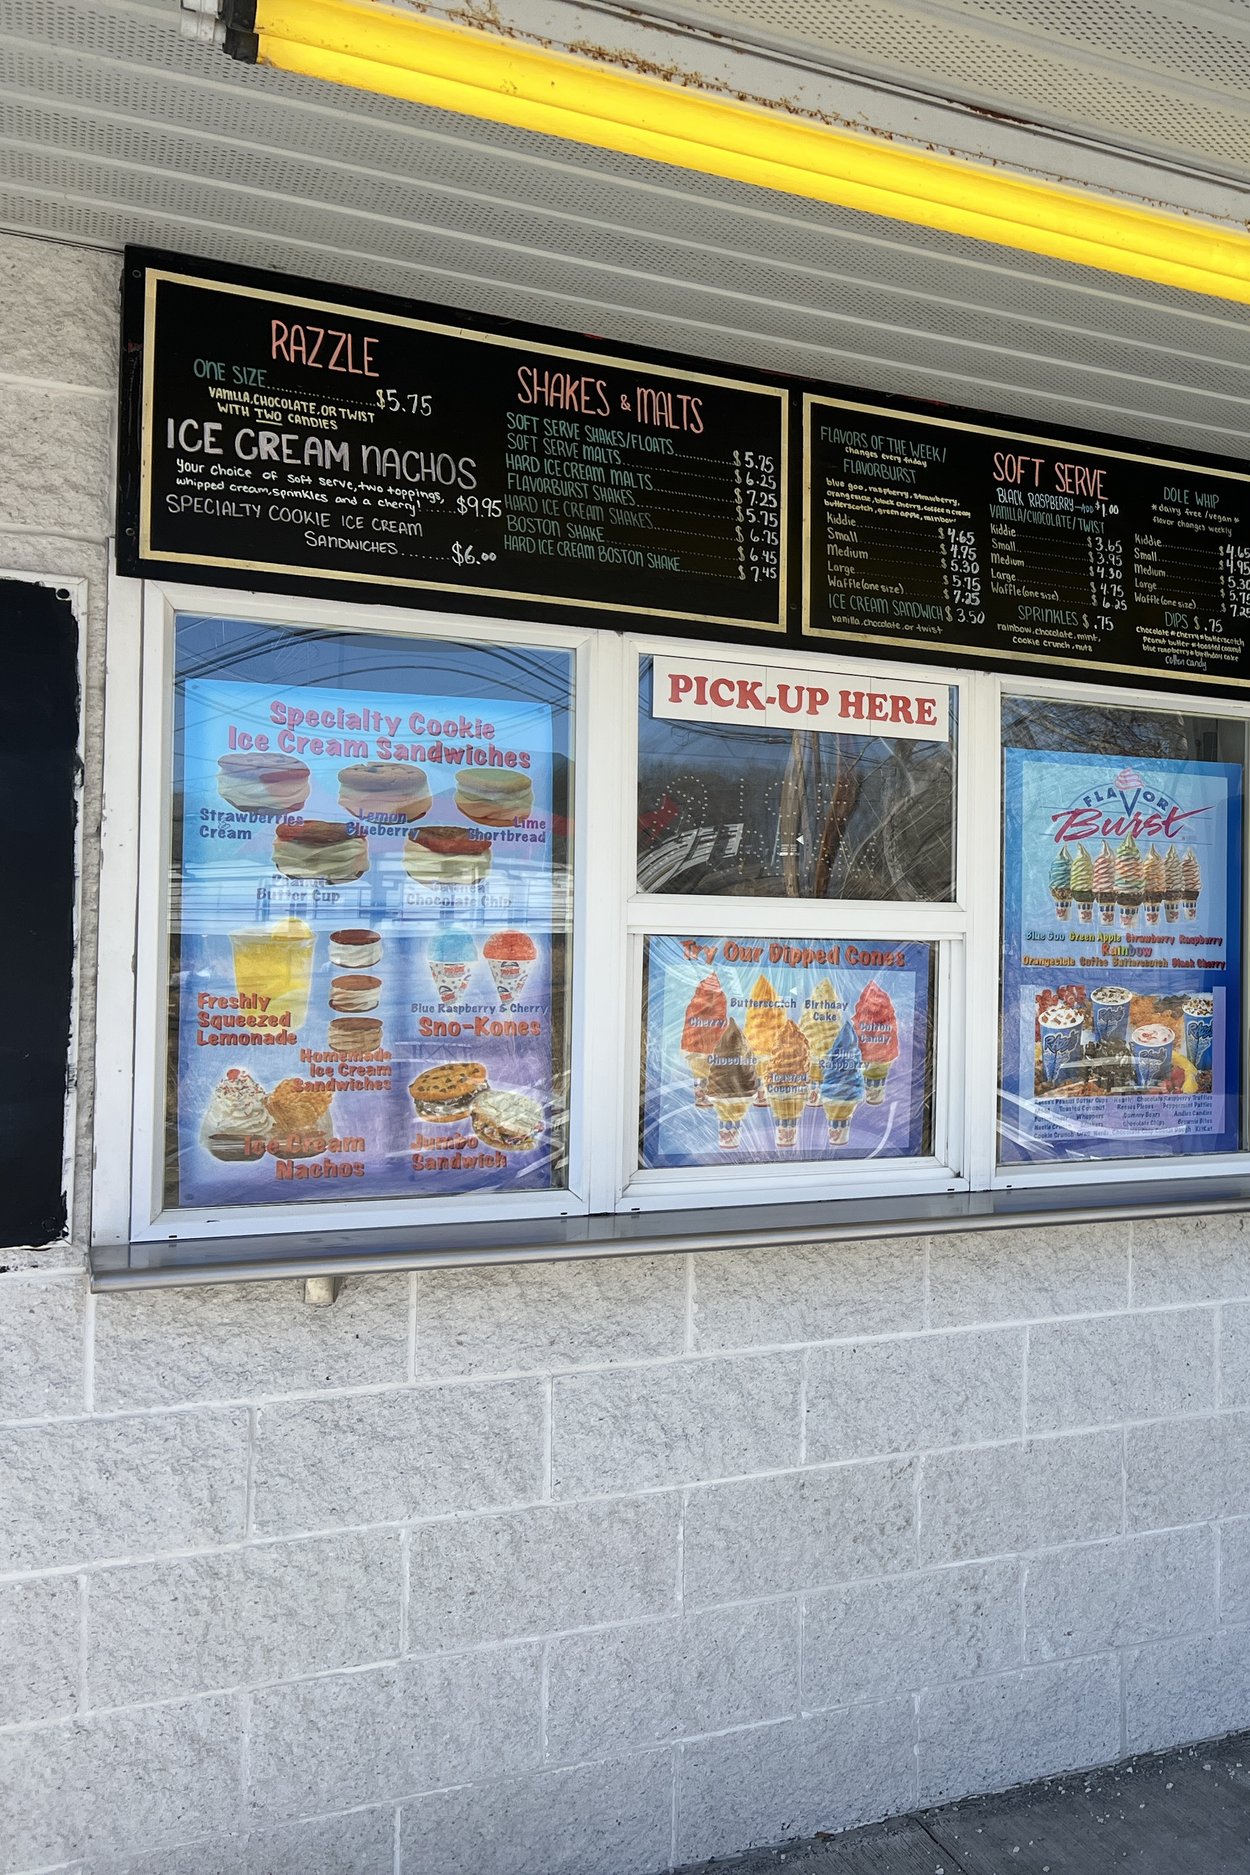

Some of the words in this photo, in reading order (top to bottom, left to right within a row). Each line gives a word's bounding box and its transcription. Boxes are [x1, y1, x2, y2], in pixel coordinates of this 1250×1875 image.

[271, 320, 379, 377] RAZZLE
[194, 359, 226, 381] ONE
[233, 366, 267, 388] SIZE
[376, 390, 433, 416] $5.75
[517, 366, 610, 416] SHAKES
[621, 394, 631, 410] &
[637, 387, 704, 433] MALTS
[217, 403, 249, 417] WITH
[256, 409, 282, 421] TWO
[288, 413, 338, 429] CANDIES
[339, 408, 375, 423] TWIST
[507, 412, 539, 433] SOFT
[544, 419, 580, 440] SERVE
[507, 433, 538, 452] SOFT
[543, 438, 579, 458] SERVE
[583, 444, 622, 465] MALTS
[821, 426, 868, 448] FLAVORS
[871, 435, 883, 449] OF
[886, 437, 906, 453] THE
[166, 418, 223, 454] ICE
[235, 428, 349, 471] CREAM
[361, 445, 477, 490] NACHOS
[211, 464, 252, 478] choice
[262, 471, 278, 480] of
[287, 473, 312, 484] soft
[506, 453, 540, 473] HARD
[544, 459, 561, 475] ICE
[563, 465, 605, 483] CREAM
[610, 469, 653, 490] MALTS
[843, 459, 916, 484] FLAVORBURST
[993, 452, 1045, 487] SOFT
[1055, 462, 1109, 500] SERVE
[176, 478, 224, 490] whipped
[335, 494, 357, 505] and
[508, 473, 588, 500] FLAVORBURST
[593, 487, 636, 506] SHAKES
[997, 488, 1024, 506] BLACK
[1164, 486, 1190, 504] DOLE
[1195, 492, 1219, 509] WHIP
[166, 494, 261, 518] SPECIALTY
[268, 505, 330, 527] COOKIE
[341, 515, 364, 529] ICE
[372, 517, 423, 537] CREAM
[504, 495, 538, 513] HARD
[542, 499, 560, 516] ICE
[564, 501, 604, 521] CREAM
[609, 509, 653, 529] SHAKES
[827, 512, 857, 527] Kiddie
[507, 515, 560, 537] BOSTON
[567, 523, 605, 542] SHAKE
[827, 528, 858, 543] Small
[304, 531, 398, 554] SANDWICHES
[1135, 533, 1162, 547] Kiddie
[504, 535, 536, 554] HARD
[538, 538, 554, 555] ICE
[557, 540, 595, 559] CREAM
[598, 546, 643, 568] BOSTON
[647, 553, 681, 572] SHAKE
[827, 544, 869, 559] Medium
[1134, 549, 1158, 562] Small
[827, 561, 856, 575] Large
[1134, 564, 1166, 577] Medium
[1135, 578, 1157, 591] Large
[828, 594, 846, 609] ICE
[850, 597, 890, 615] CREAM
[893, 600, 943, 621] SANDWICH
[1017, 605, 1079, 627] SPRINKLES
[1165, 612, 1188, 629] DIPS
[668, 673, 829, 715] PICK-UP
[838, 690, 938, 726] HERE
[270, 700, 401, 737] Specialty
[408, 712, 495, 740] Cookie
[228, 725, 270, 753] Ice
[277, 730, 368, 759] Cream
[377, 736, 531, 769] Sandwiches
[1083, 788, 1170, 818] FLAVOR
[200, 808, 304, 826] Strawberries
[359, 808, 407, 823] Lemon
[513, 817, 546, 829] Lime
[1052, 806, 1216, 843] Burst
[200, 825, 252, 839] Cream
[346, 822, 419, 839] Blueberry
[467, 829, 546, 843] Shortbread
[256, 888, 308, 902] Butter
[312, 889, 340, 904] Cup
[407, 893, 477, 907] Chocolate
[681, 940, 717, 964] Try
[724, 941, 764, 962] Our
[768, 942, 840, 967] Dipped
[845, 945, 906, 967] Cones
[1101, 943, 1152, 956] Rainbow
[197, 993, 271, 1012] Freshly
[411, 1003, 434, 1014] Blue
[438, 1003, 496, 1015] Raspberry
[510, 1003, 548, 1015] Cherry
[730, 998, 797, 1008] Butterscotch
[804, 1000, 848, 1010] Birthday
[197, 1011, 291, 1030] Squeezed
[813, 1012, 837, 1021] Cake
[419, 1017, 542, 1037] Sno-Kones
[197, 1029, 297, 1046] Lemonade
[300, 1048, 392, 1063] Homemade
[310, 1063, 335, 1077] Ice
[338, 1064, 392, 1077] Cream
[291, 1077, 392, 1092] Sandwiches
[244, 1135, 279, 1156] Ice
[286, 1134, 365, 1155] Cream
[410, 1133, 478, 1151] Jumbo
[275, 1157, 365, 1180] Nachos
[411, 1151, 508, 1171] Sandwich
